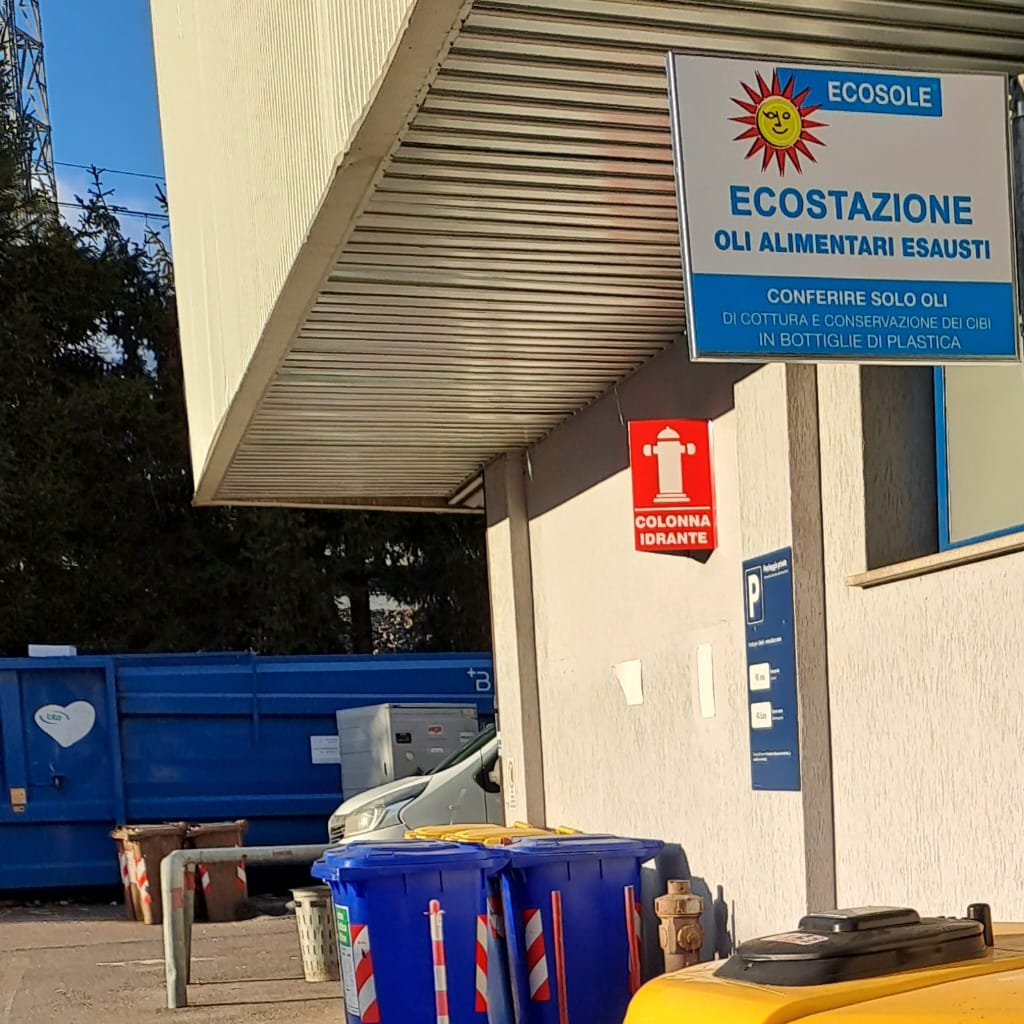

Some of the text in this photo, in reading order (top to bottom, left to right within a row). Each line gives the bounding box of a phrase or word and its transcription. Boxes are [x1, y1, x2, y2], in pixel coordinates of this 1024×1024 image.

[827, 80, 933, 108] ECOSOLE
[729, 184, 973, 225] ECOSTAZIONE
[713, 229, 991, 260] OLI ALIMENTARI ESAUSTI
[767, 288, 948, 308] CONFERIRE SOLO OLI
[722, 311, 992, 330] DI COTTURA E CONSERVAZIONE DEI CIBI
[759, 331, 962, 350] IN BOTTIGLIE DI PLASTICA
[635, 514, 711, 529] COLONNA
[640, 531, 708, 546] IDRANTE
[747, 573, 760, 619] P
